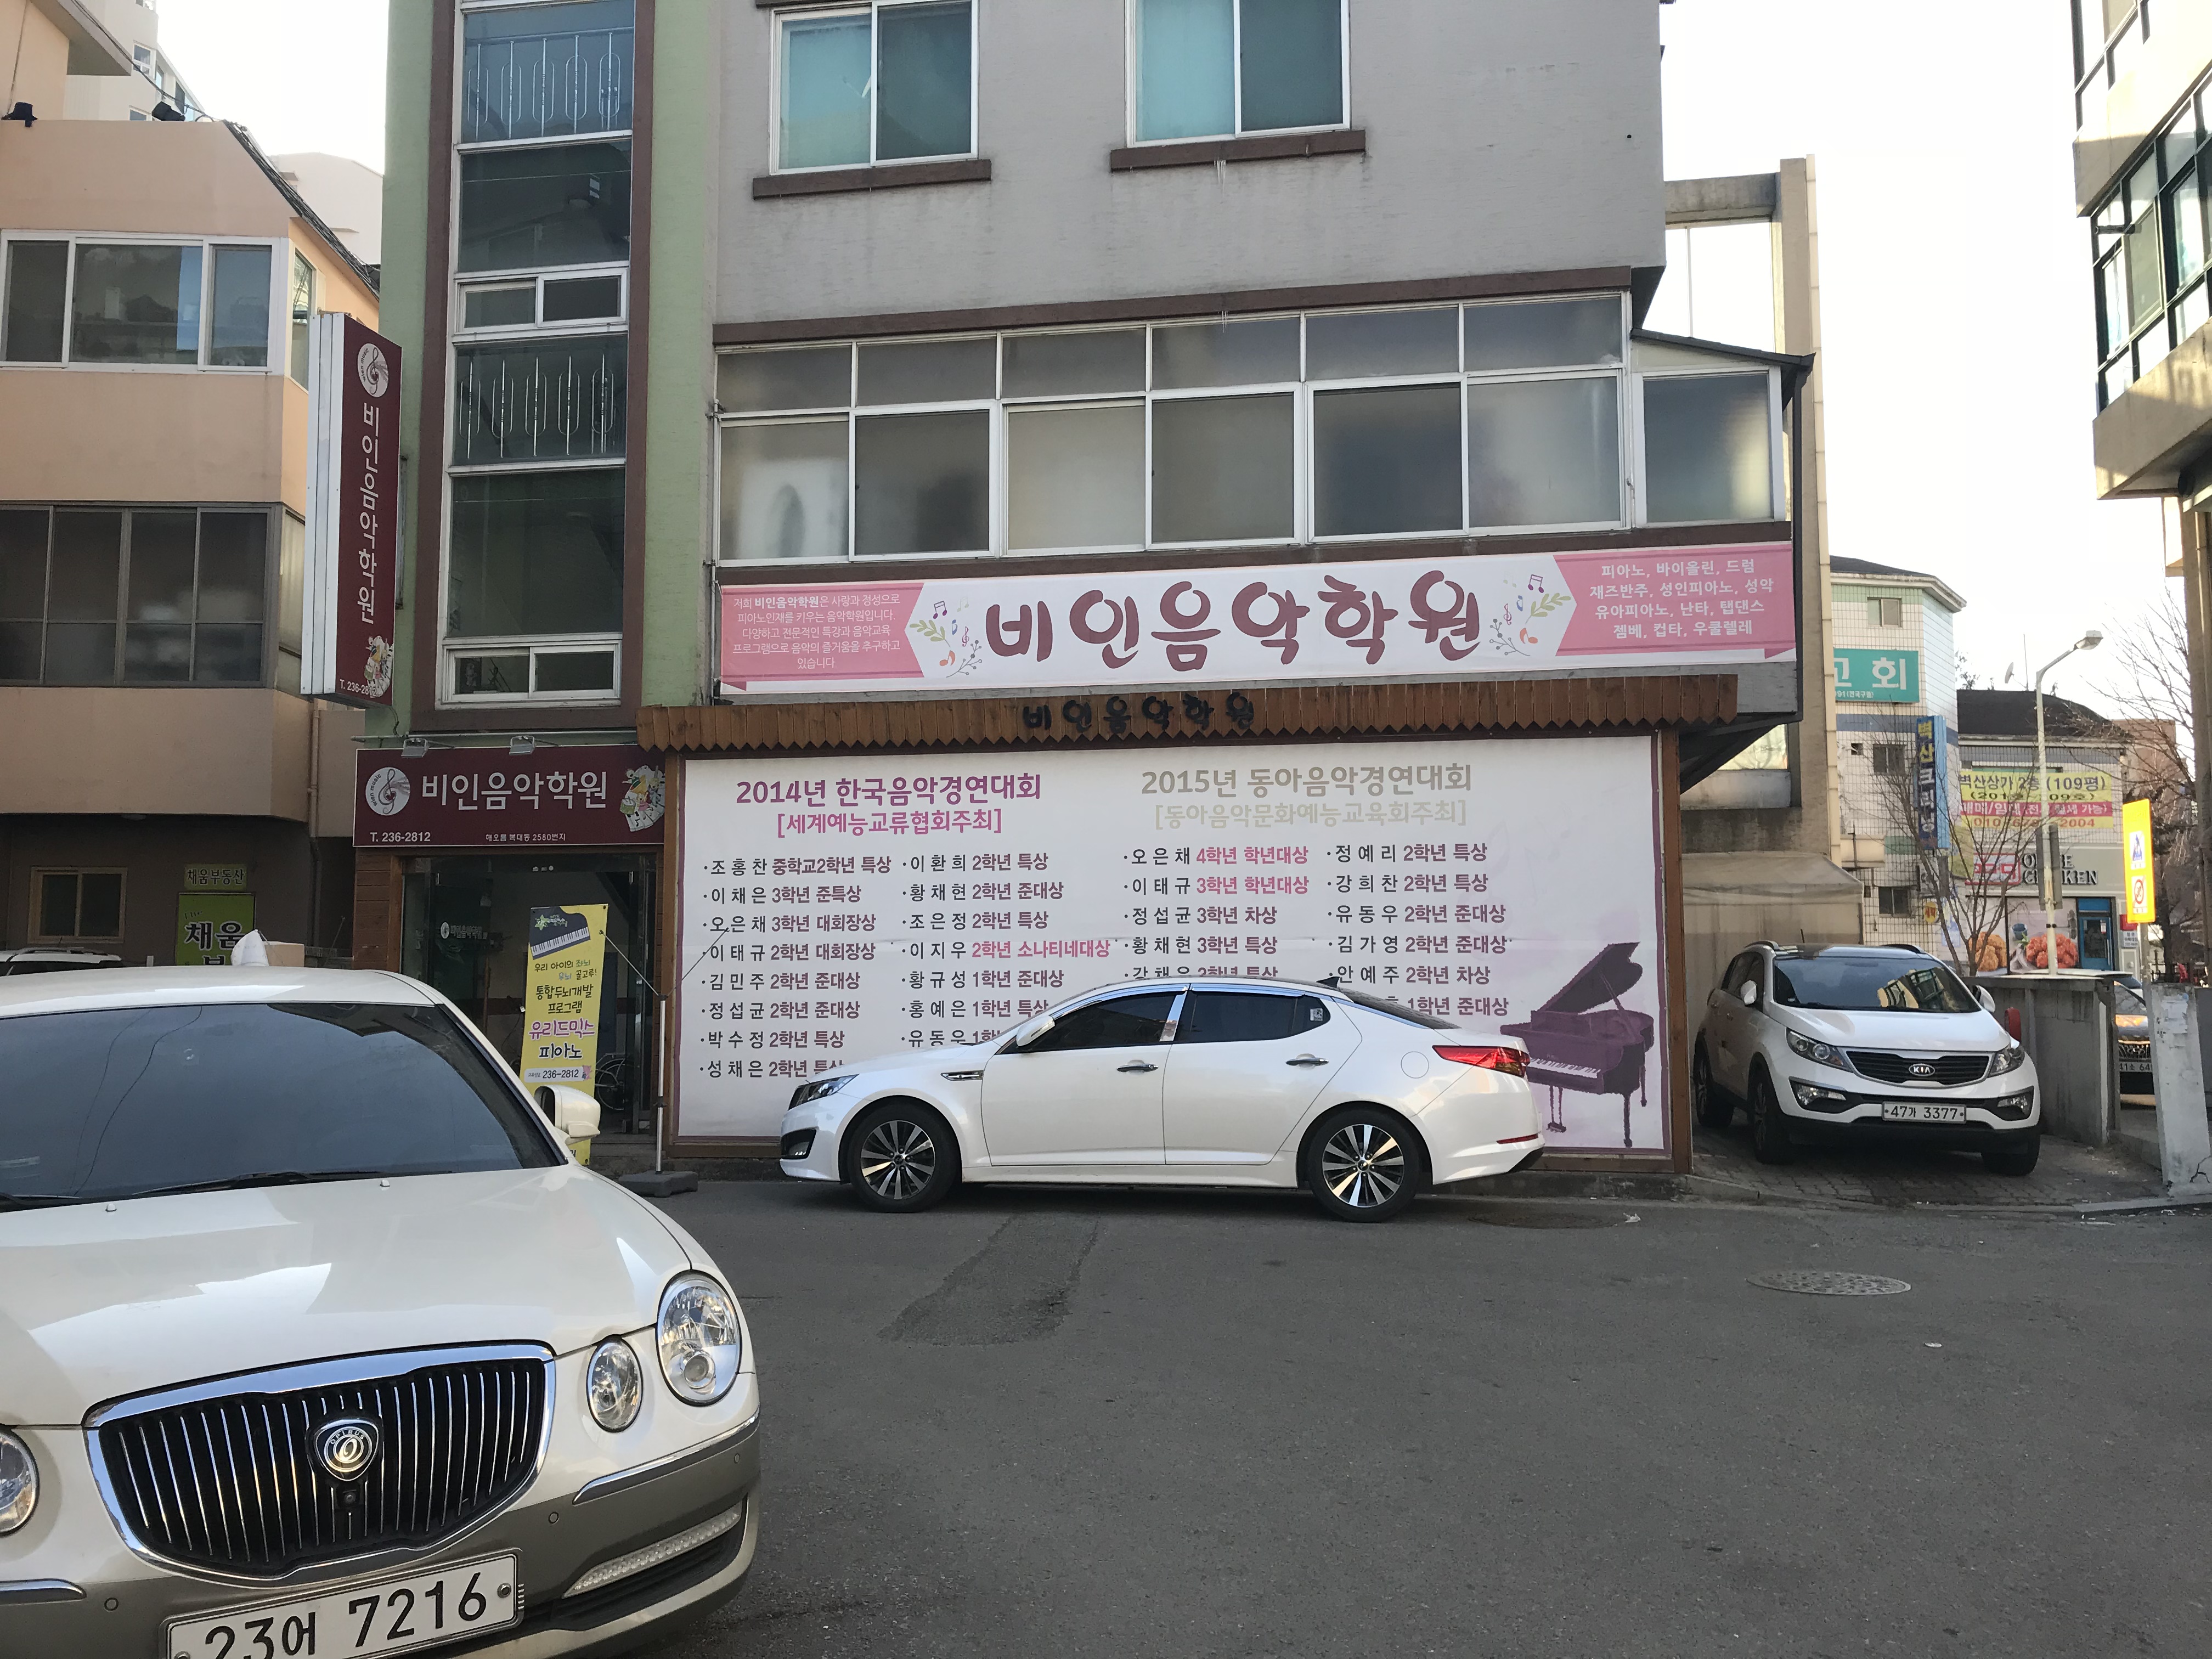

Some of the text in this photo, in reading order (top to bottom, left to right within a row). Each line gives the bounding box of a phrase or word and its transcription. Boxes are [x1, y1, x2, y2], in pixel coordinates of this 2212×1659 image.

[1602, 559, 1754, 578] 피아노, 바이올린, 드럼
[1590, 578, 1774, 599] 재즈반주, 성인피아노, 성악
[733, 594, 901, 610] 저희 비인음악학원은 사랑과 정성으로
[1595, 600, 1764, 619] 유아피아노, 난타, 탭댄스
[737, 609, 895, 625] 피아노인재를 키우는 음악학원입니다.
[986, 568, 1480, 670] 비인음악학원
[742, 624, 891, 640] 다양하고 전문적인 특강과 음악교육
[1613, 620, 1752, 639] 젬베, 컵타, 우쿨렐레
[732, 640, 900, 654] 프로그램으로 음악의 즐거움을 추구하고
[797, 657, 836, 669] 있습니다
[1023, 692, 1255, 734] 비인음악학원
[1142, 763, 1470, 798] 2015년 동아음악경연대회
[421, 771, 608, 811] 비인음악학원
[737, 773, 1040, 807] 2014년 한국음악경연대회
[778, 809, 1001, 838] [세계예능교류협회주최]
[1155, 800, 1466, 830] [동아음악문화예능교육회주최]
[370, 832, 431, 842] T. 236-2812
[1197, 847, 1237, 865] 4학년
[1244, 847, 1308, 864] 학년대상
[1404, 844, 1446, 862] 2학년
[1453, 843, 1487, 861] 특상
[772, 857, 854, 875] 중학교2학년
[861, 856, 891, 873] 특상
[973, 854, 1011, 871] 2학년
[1018, 853, 1048, 870] 특상
[187, 868, 244, 885] 채움부동산
[1197, 877, 1237, 894] 3학년
[1245, 876, 1309, 894] 학년대상
[1404, 874, 1446, 892] 2학년
[1454, 874, 1488, 892] 특상
[772, 887, 809, 904] 3학년
[816, 885, 861, 902] 준특상
[973, 883, 1011, 900] 2학년
[1018, 882, 1063, 899] 준대상
[772, 915, 809, 932] 3학년
[817, 914, 876, 932] 대회장상
[973, 912, 1011, 929] 2학년
[1018, 911, 1048, 929] 특상
[1197, 906, 1237, 924] 3학년
[1245, 907, 1277, 924] 차상
[1405, 905, 1447, 923] 2학년
[1455, 905, 1506, 923] 준대상
[771, 944, 809, 961] 2학년
[816, 943, 876, 960] 대회장상
[972, 941, 1011, 958] 2학년
[1018, 940, 1110, 958] 소나티네대상
[1198, 936, 1238, 954] 3학년
[1245, 936, 1277, 954] 특상
[1406, 935, 1448, 953] 2학년
[1456, 935, 1507, 953] 준대상
[534, 963, 548, 972] 우리
[550, 961, 573, 970] 아이의
[1338, 965, 1490, 984] 안예주 2학년 차상
[770, 973, 808, 990] 2학년
[815, 972, 860, 989] 준대상
[973, 970, 1010, 988] 1학년
[1018, 970, 1064, 988] 준대상
[548, 1001, 582, 1014] 프로그램
[770, 1002, 808, 1019] 2학년
[815, 1001, 860, 1019] 준대상
[973, 1000, 1011, 1018] 1학년
[1458, 997, 1509, 1016] 준대상
[529, 1018, 595, 1039] 유리드믹스
[770, 1031, 807, 1048] 2학년
[814, 1031, 844, 1048] 특상
[539, 1043, 582, 1058] 피아노
[543, 1069, 579, 1079] 236-2812
[769, 1060, 806, 1077] 2학년
[1891, 1108, 1957, 1120] 47가 3377
[330, 1430, 365, 1444] OPIRUS
[348, 1572, 487, 1647] 7216
